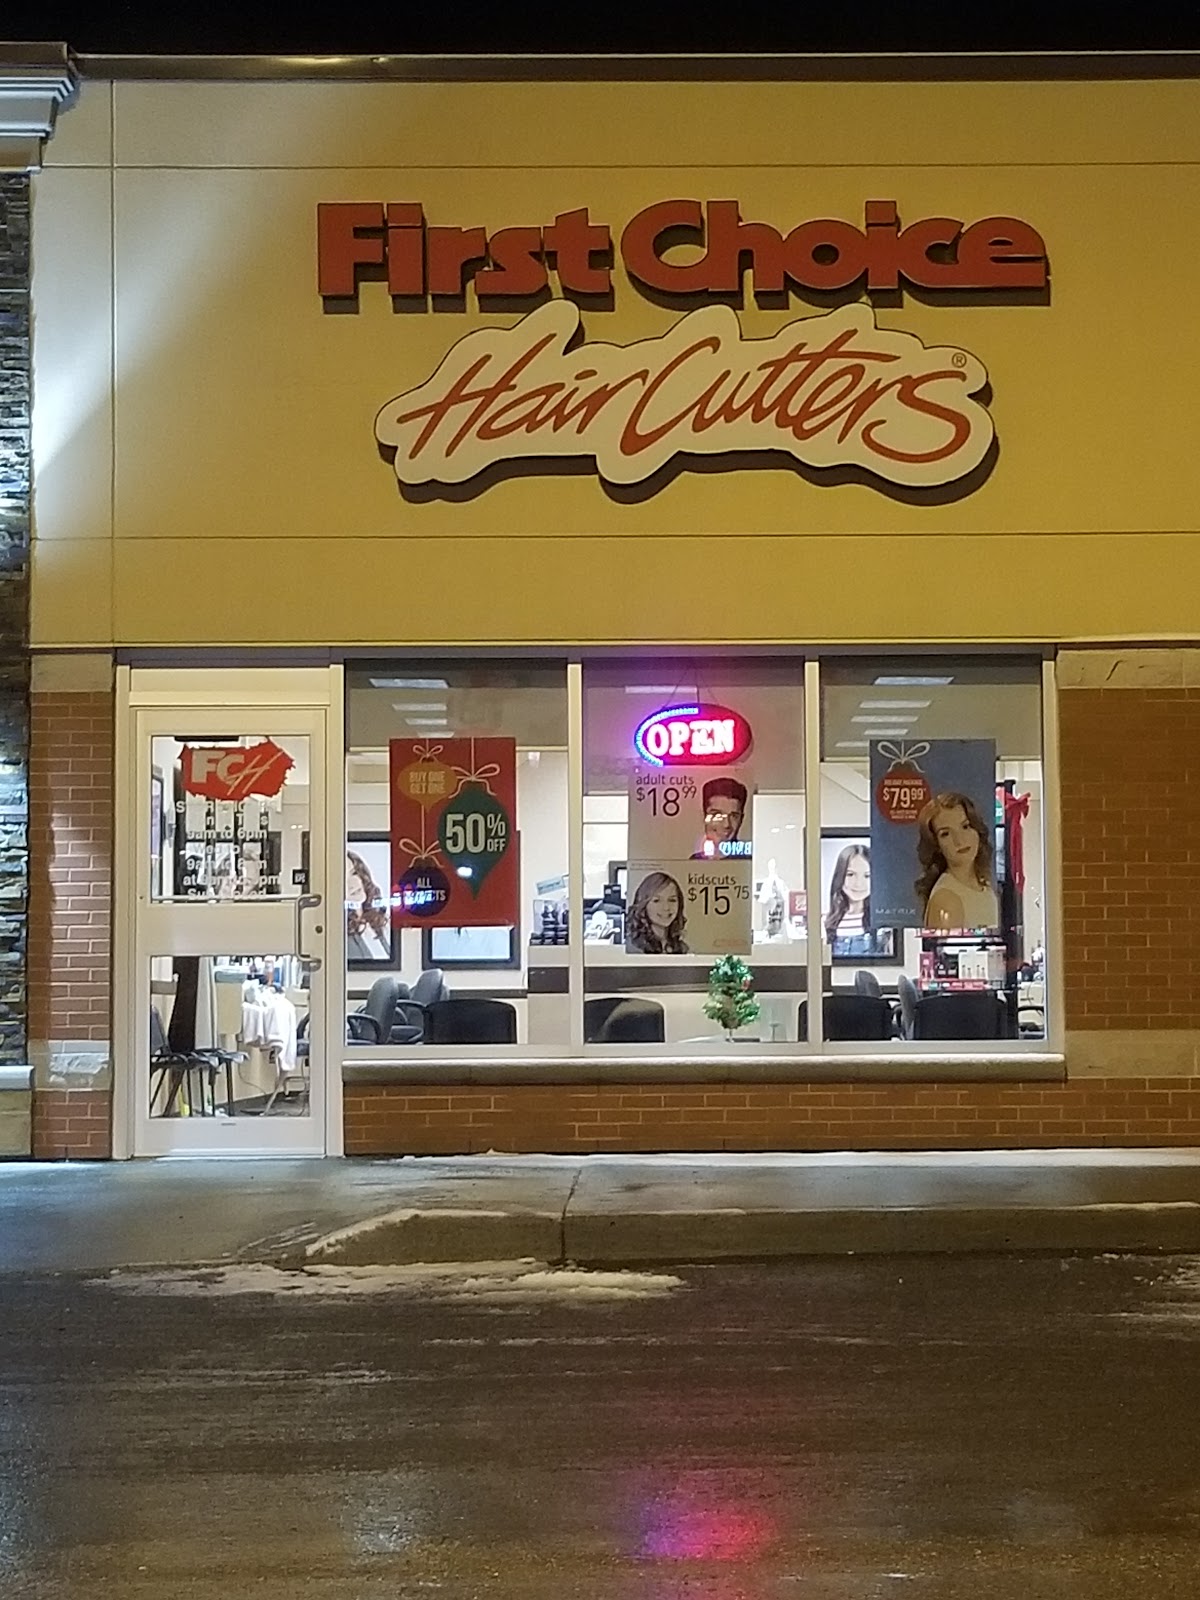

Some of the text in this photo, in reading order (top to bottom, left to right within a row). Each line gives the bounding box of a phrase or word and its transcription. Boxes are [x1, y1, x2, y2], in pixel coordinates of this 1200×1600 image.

[318, 199, 1047, 300] First Choice
[646, 718, 736, 756] OPEN
[636, 774, 695, 785] adult cuts
[487, 838, 506, 852] OFF
[416, 877, 432, 889] ALL
